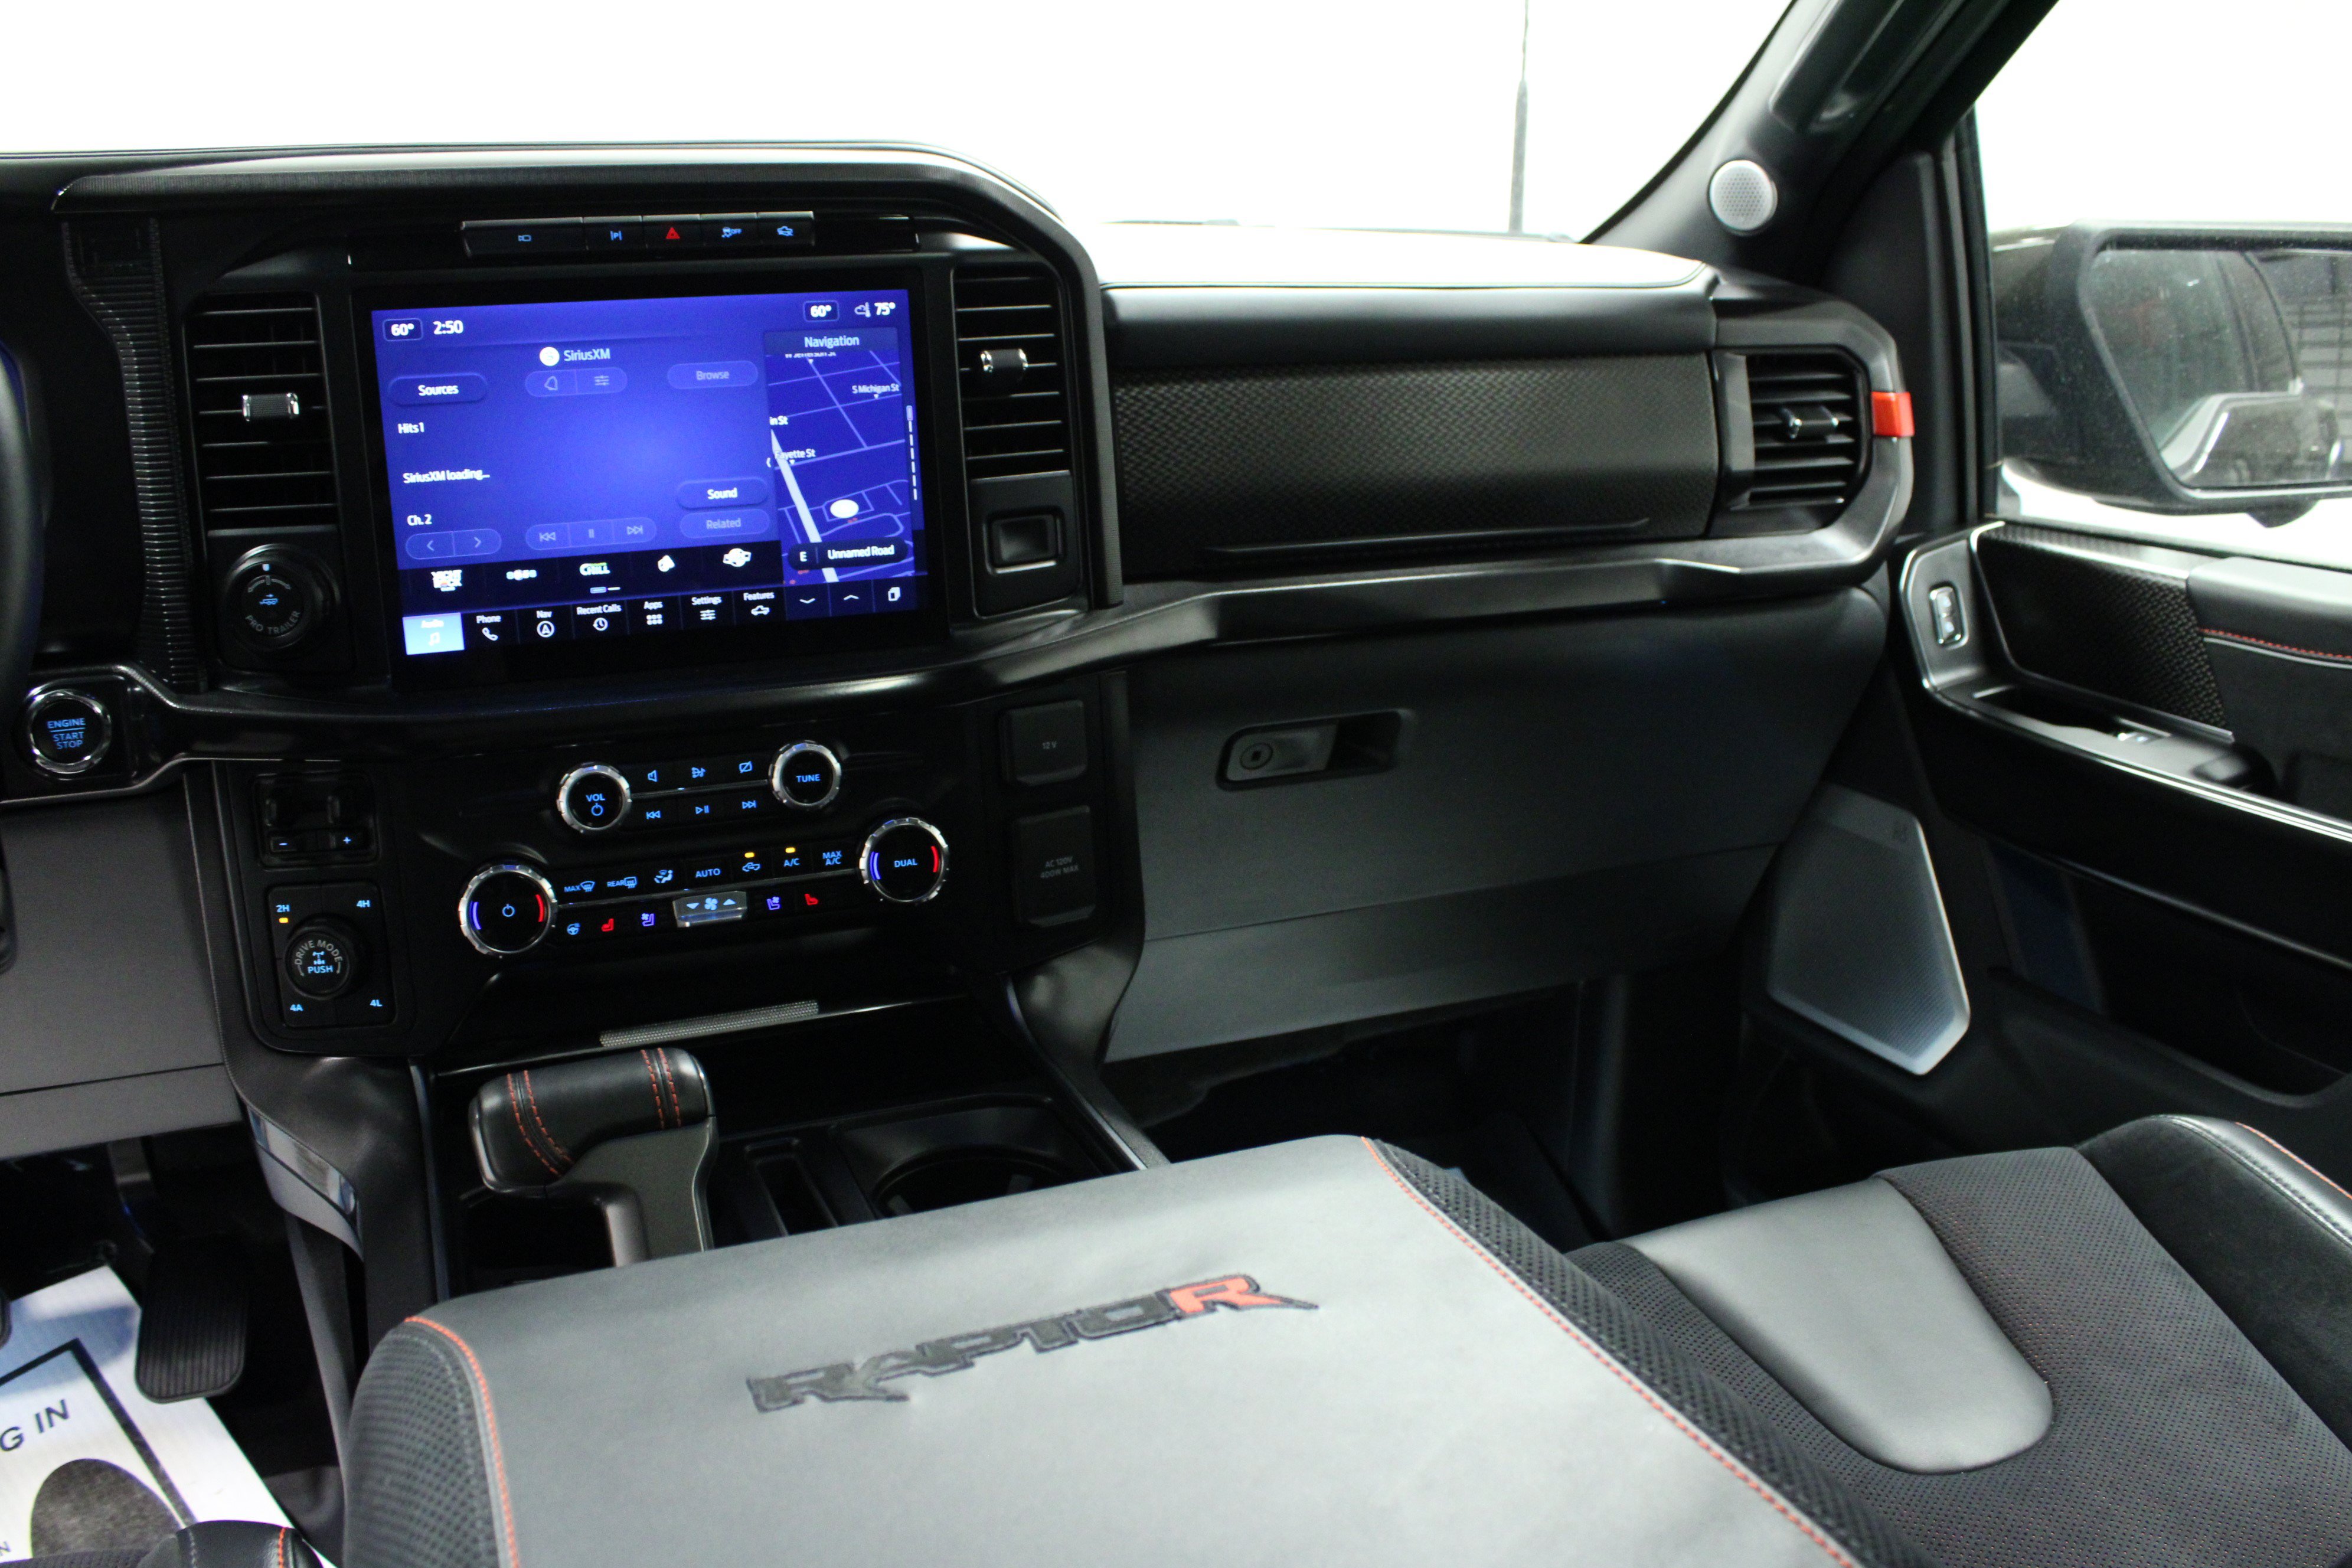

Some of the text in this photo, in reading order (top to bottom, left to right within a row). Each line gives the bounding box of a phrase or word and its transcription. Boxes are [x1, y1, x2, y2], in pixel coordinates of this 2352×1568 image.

[433, 320, 464, 335] 2:50
[804, 335, 860, 348] Navigation
[564, 349, 610, 362] SiriusXM
[697, 370, 730, 381] Browse
[418, 384, 459, 397] Sources
[858, 384, 890, 394] Michigan
[890, 383, 899, 392] St
[398, 423, 417, 435] Hits
[403, 471, 446, 484] SiriusXM
[707, 488, 738, 499] Sound
[407, 514, 432, 526] Ch. 2
[706, 518, 741, 530] Related
[800, 551, 807, 562] E
[828, 545, 894, 560] Unnamed Road
[691, 596, 722, 606] Settings
[743, 592, 775, 601] Features
[577, 604, 622, 615] Recent Calls
[644, 600, 663, 610] Apps
[537, 610, 553, 619] Nav
[267, 610, 301, 635] TRAILER
[47, 718, 86, 729] ENGINE
[53, 731, 84, 741] START
[57, 740, 83, 749] STOP
[796, 774, 821, 783] TUNE
[586, 793, 605, 802] VOL
[822, 850, 842, 859] MAX
[783, 857, 801, 867] A/C
[825, 857, 841, 866] A/C
[894, 858, 919, 868] DUAL
[695, 868, 721, 878] AUTO
[564, 884, 580, 893] MAX
[607, 880, 624, 888] REAR
[276, 904, 291, 913] 2H
[356, 899, 371, 908] 4H
[295, 939, 344, 966] DRIVE MODE
[307, 965, 334, 974] PUSH
[290, 1004, 304, 1012] 4A
[370, 999, 383, 1007] 4L
[746, 1273, 1319, 1412] RAPTOR
[35, 1399, 70, 1433] IN
